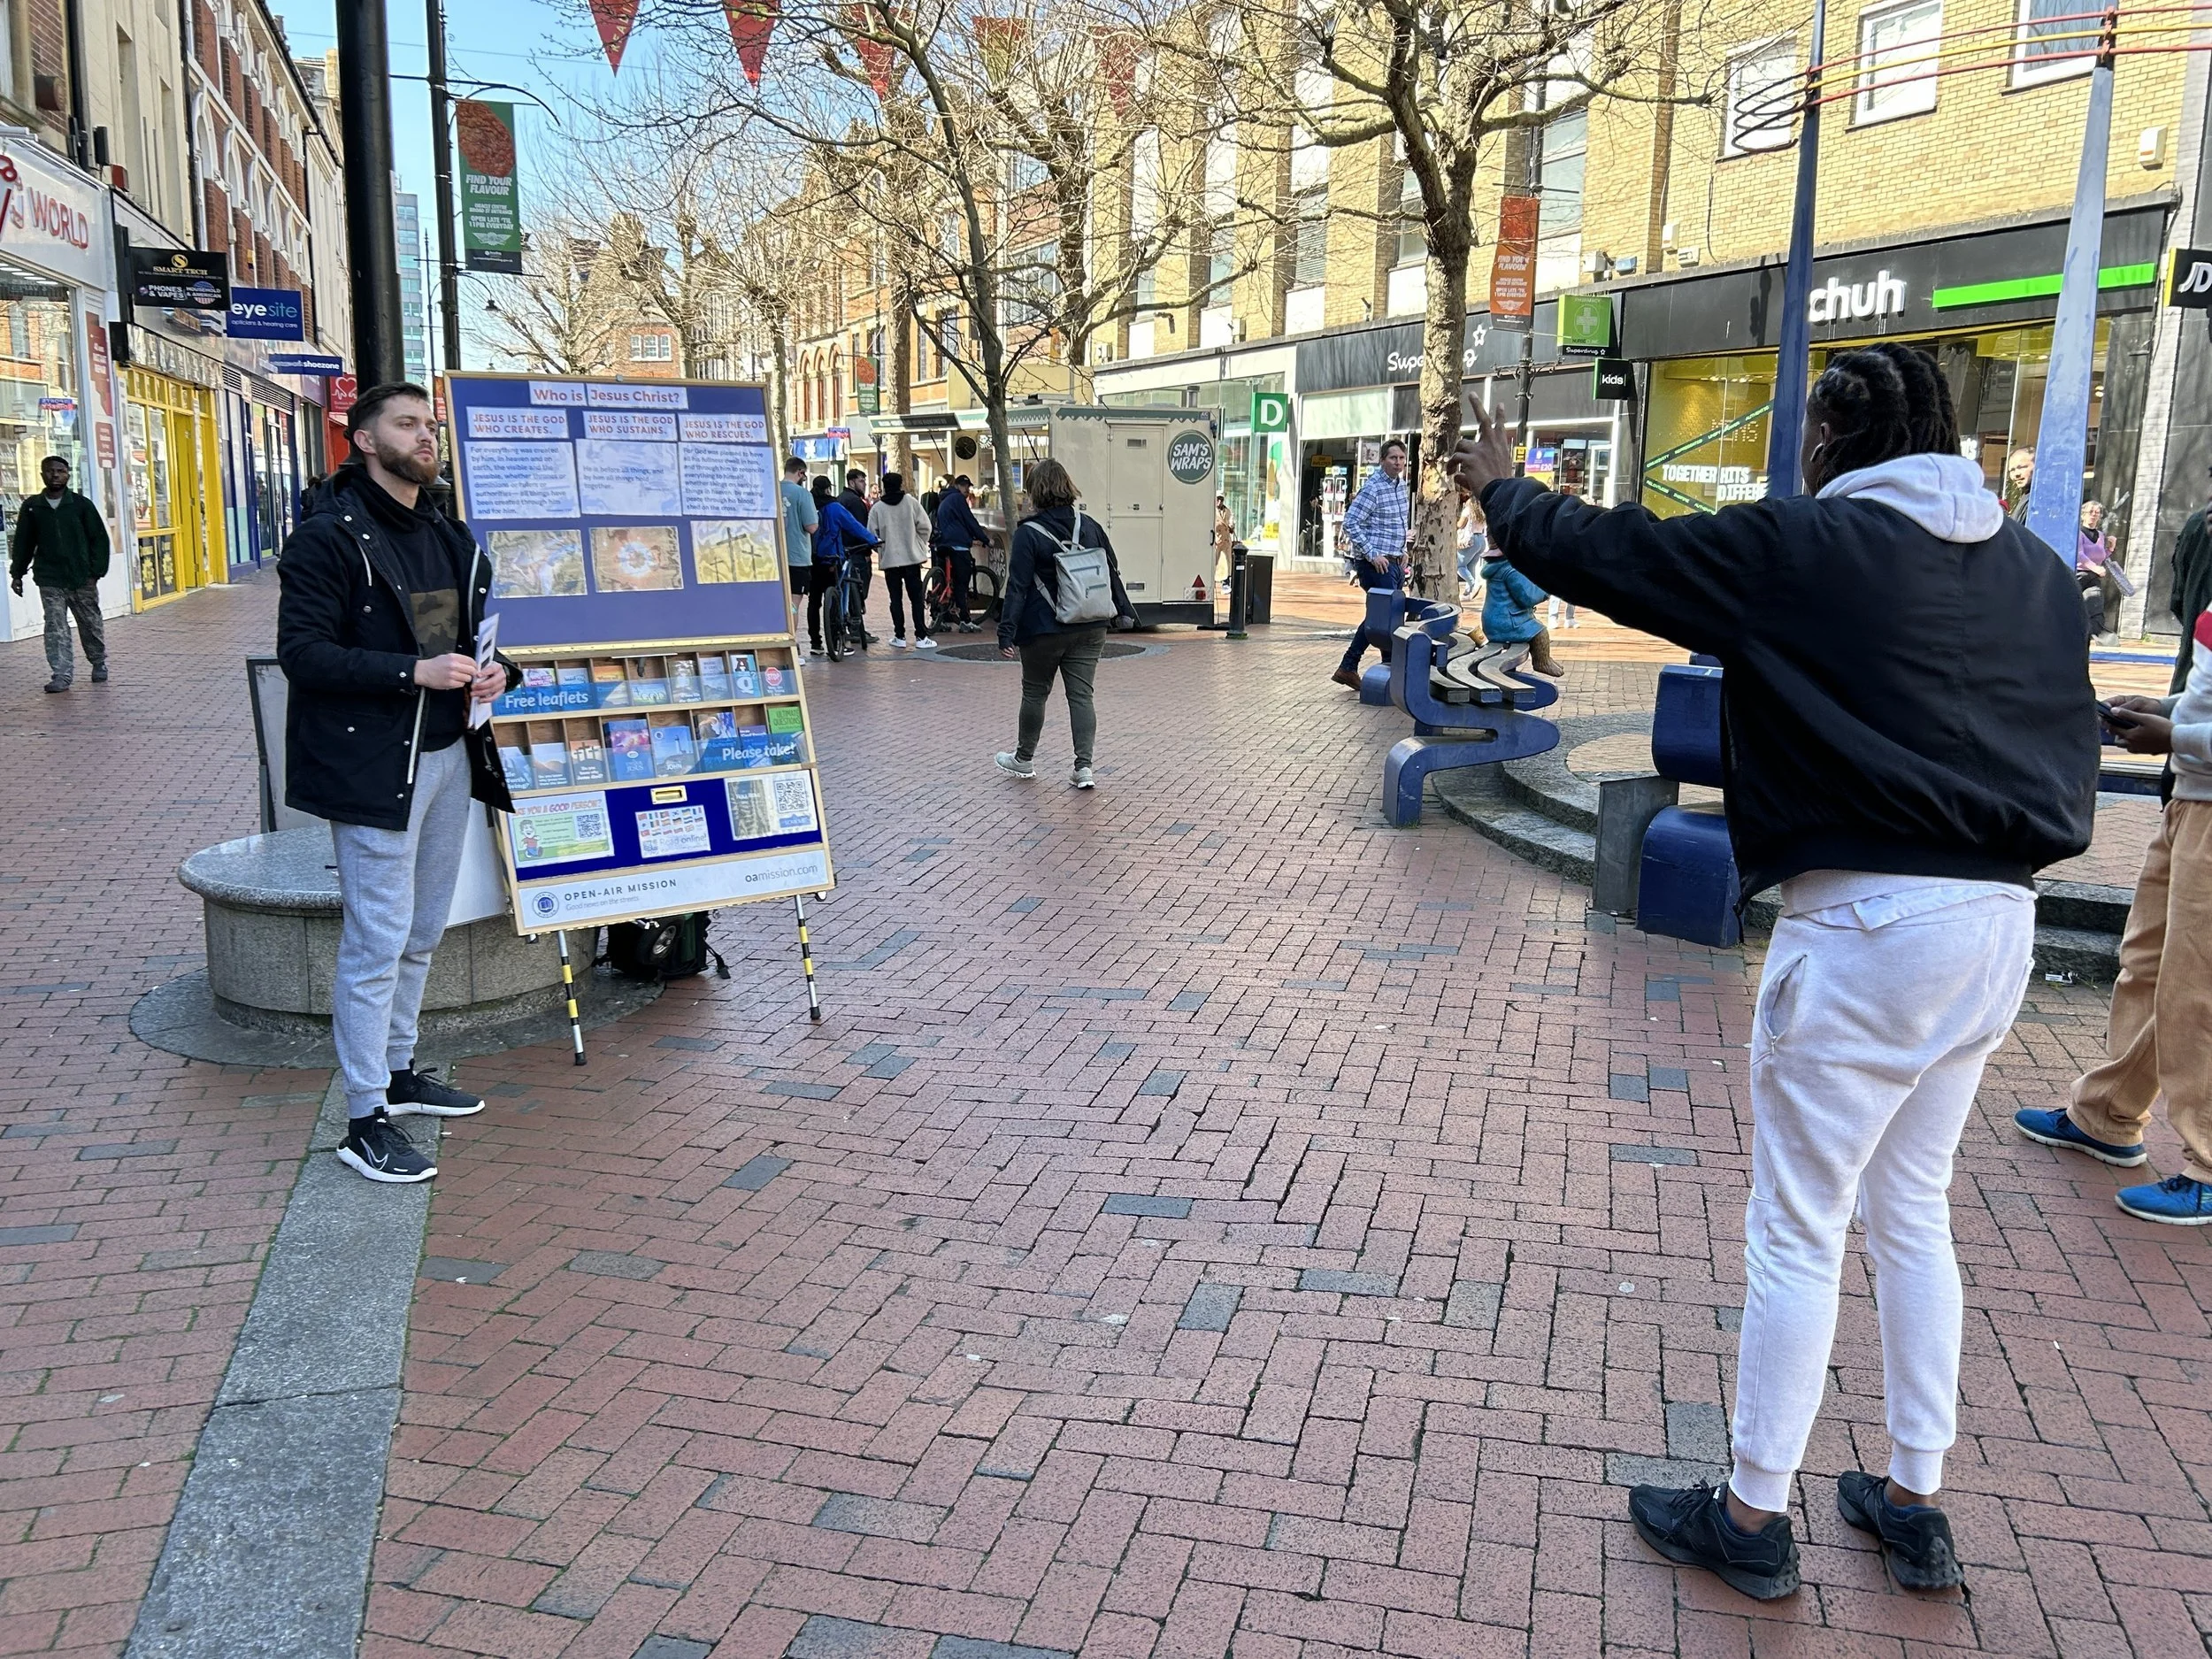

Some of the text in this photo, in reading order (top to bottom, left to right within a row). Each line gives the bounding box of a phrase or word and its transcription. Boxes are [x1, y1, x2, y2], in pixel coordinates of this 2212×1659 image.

[465, 174, 512, 187] FIND YOUR
[470, 184, 510, 196] FLAVOUR
[27, 186, 88, 250] WORLD
[2177, 261, 2212, 293] JD
[149, 284, 183, 293] PHONES
[157, 290, 184, 299] VAPES
[1809, 269, 1906, 323] chuh
[303, 360, 340, 370] shoezone
[1601, 373, 1624, 385] kids
[534, 388, 680, 403] Who is Jesus Christ?
[473, 413, 504, 422] JESUS
[1260, 399, 1283, 426] D
[588, 414, 617, 424] JESUS
[684, 420, 711, 429] JESUS
[714, 420, 723, 429] IS
[744, 420, 764, 429] GOD
[474, 425, 553, 434] WHO CREATES.
[588, 425, 667, 434] WHO SUSTAINS.
[686, 430, 754, 439] WHO RESCUES.
[1172, 442, 1210, 457] SAM'S
[1171, 456, 1212, 471] WRAPS
[1662, 464, 1751, 484] TOGETHER HITS
[505, 691, 588, 708] Free leaflets
[722, 747, 762, 761] Please
[549, 803, 570, 812] GOOD
[745, 864, 818, 882] oamission.com
[565, 879, 677, 901] OPEN-AIR MISSION
[565, 902, 583, 911] Good
